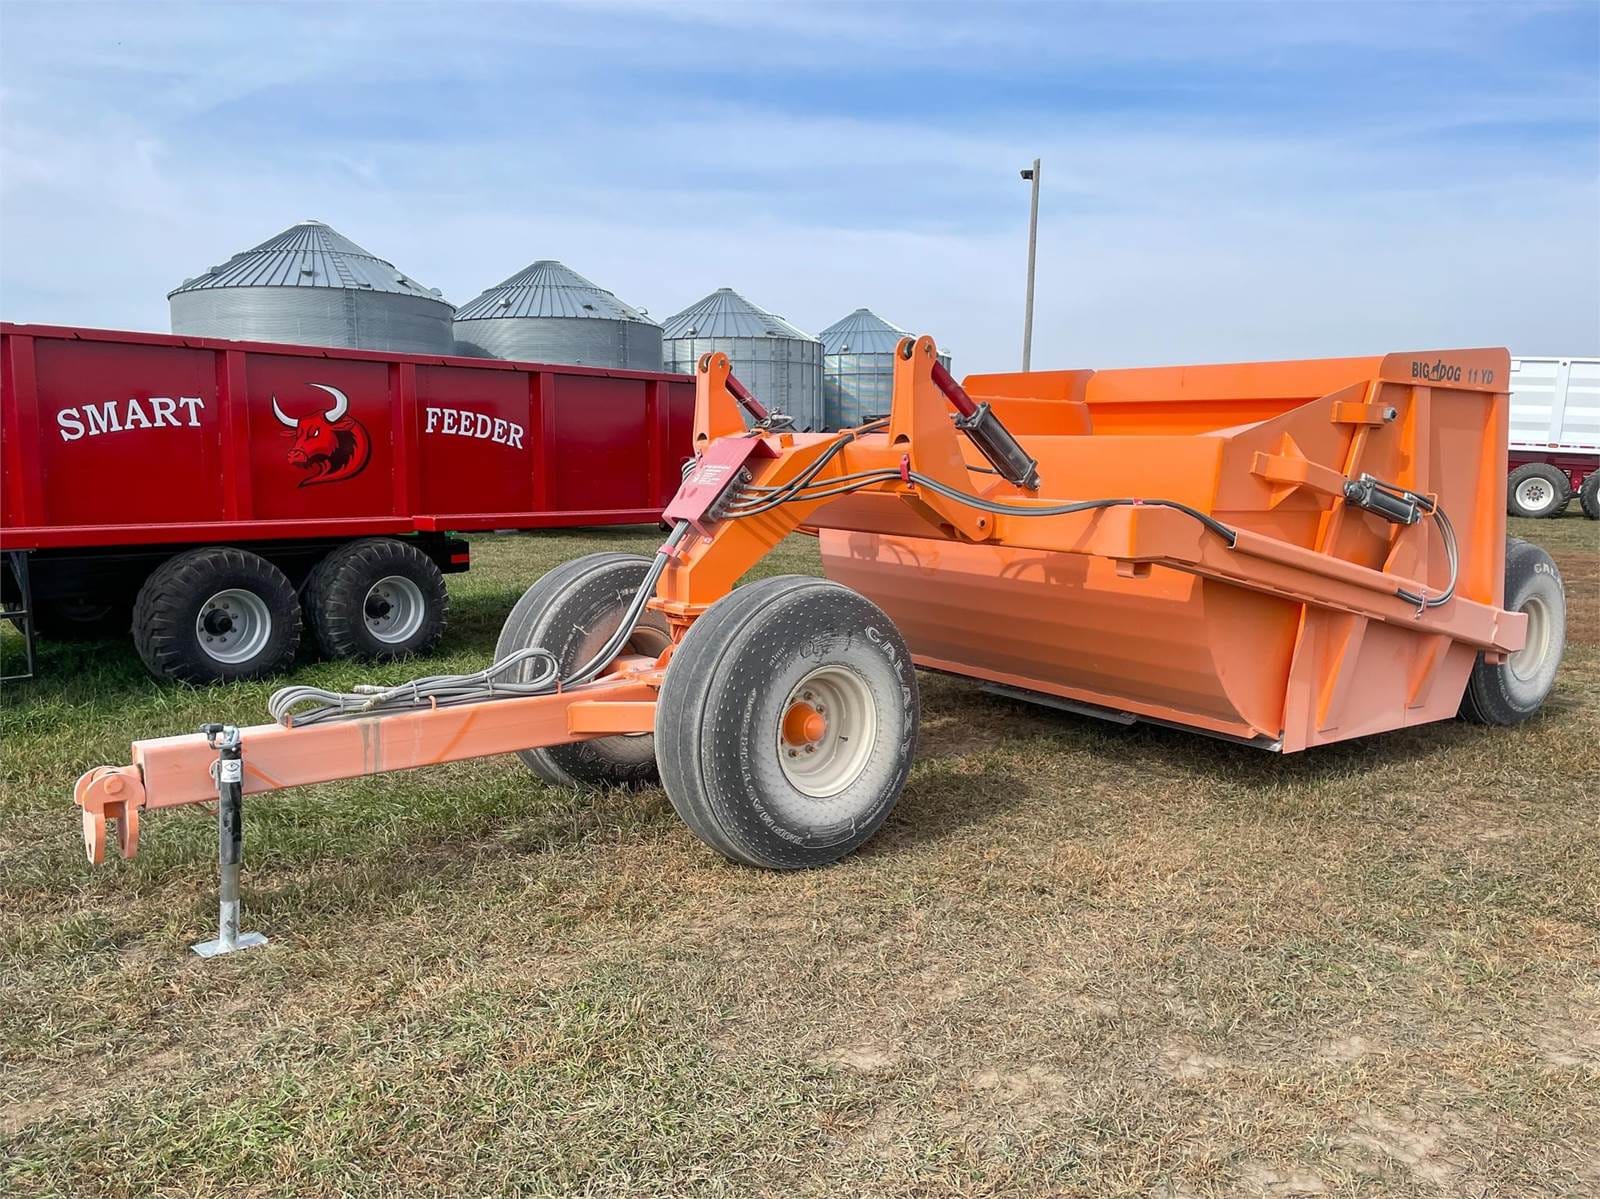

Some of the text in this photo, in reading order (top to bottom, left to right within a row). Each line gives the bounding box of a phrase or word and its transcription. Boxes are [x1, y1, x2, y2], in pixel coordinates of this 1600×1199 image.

[1412, 361, 1494, 384] BIG DOG 11 YD
[56, 396, 524, 450] SMART FEEDER
